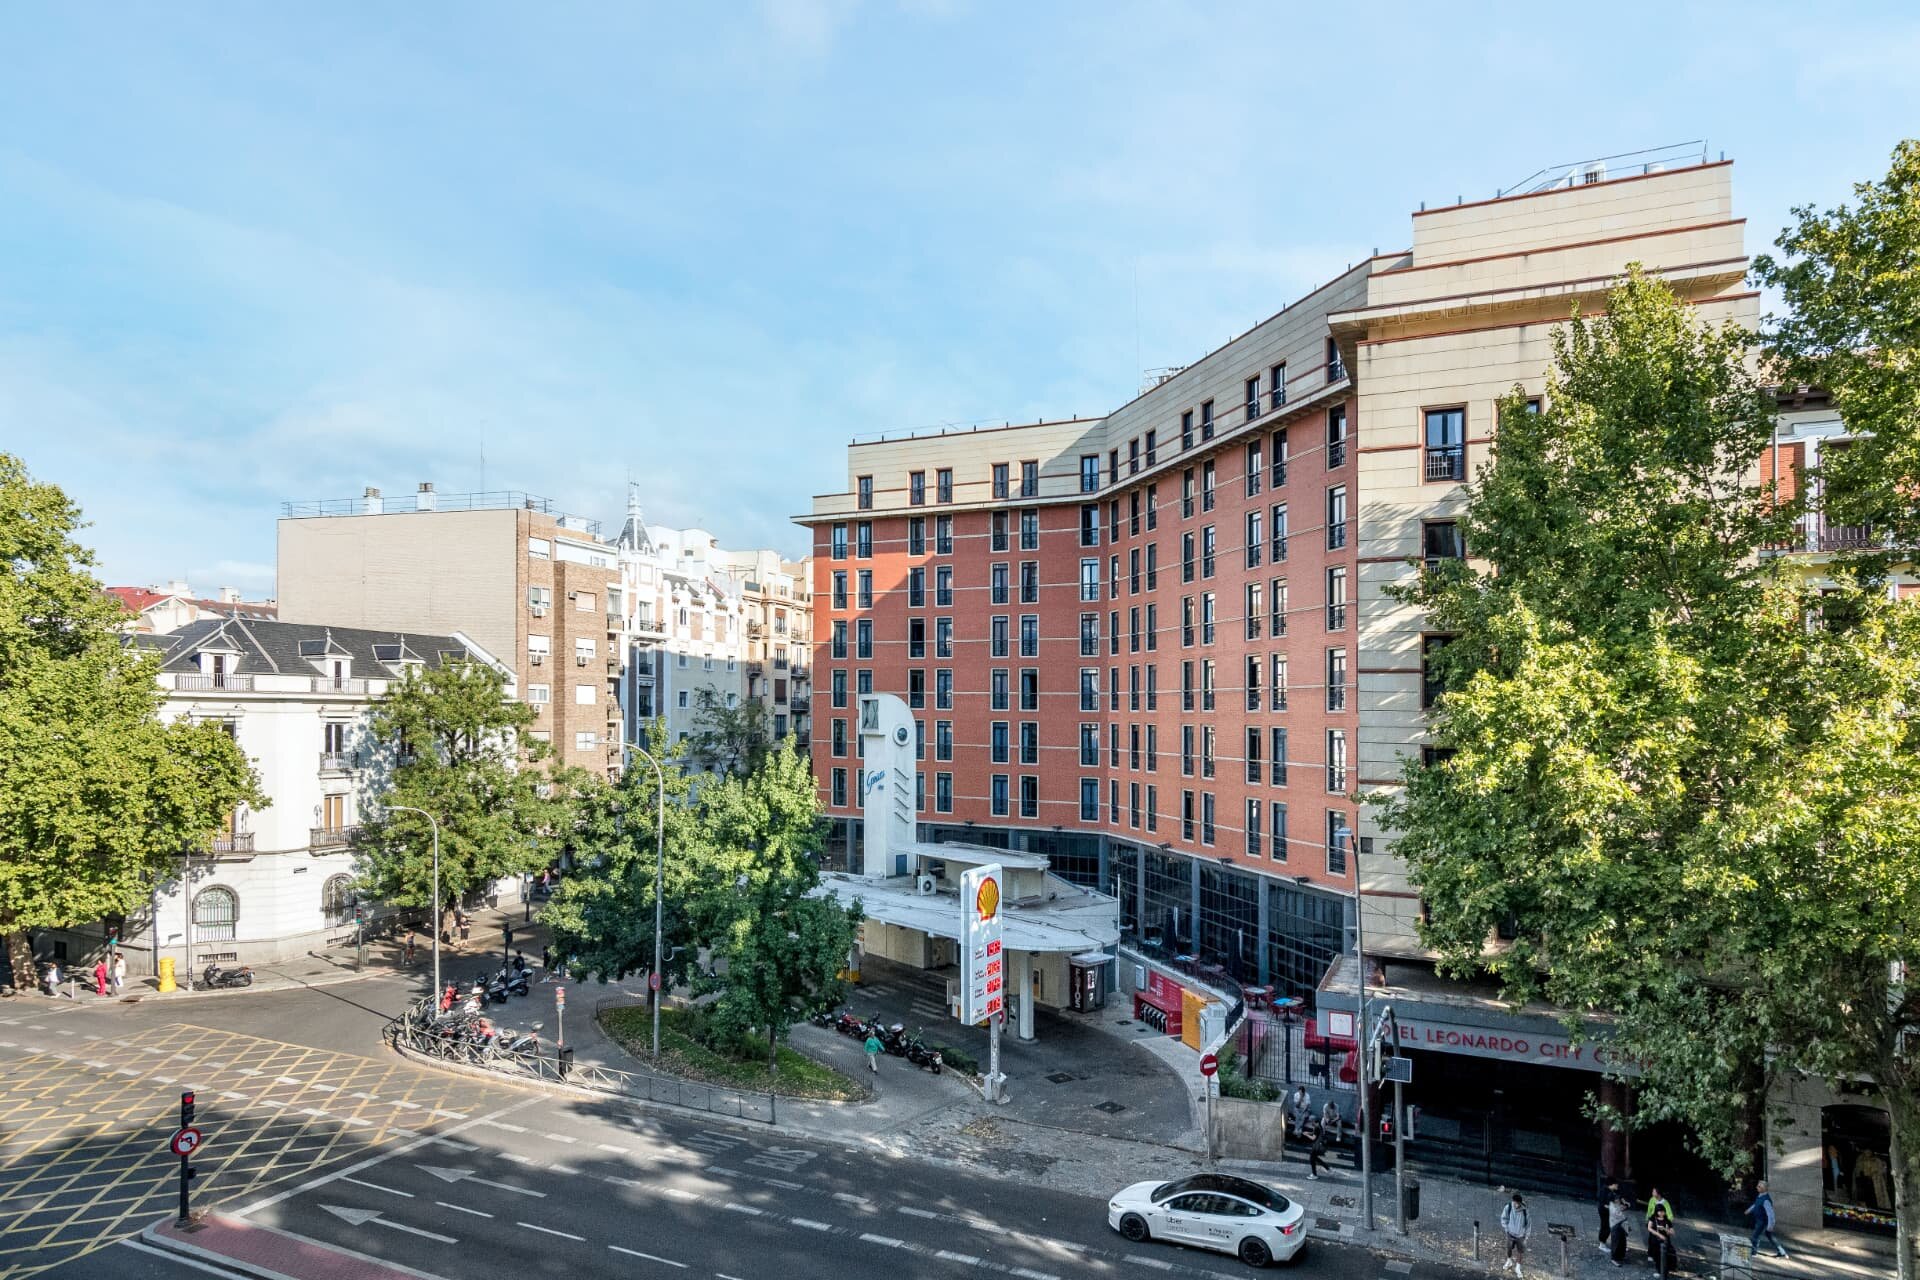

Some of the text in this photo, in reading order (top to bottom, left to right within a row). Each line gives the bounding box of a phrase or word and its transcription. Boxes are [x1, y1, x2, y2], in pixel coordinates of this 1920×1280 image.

[1426, 1028, 1529, 1054] LEONARDO
[1539, 1042, 1583, 1060] CITY
[744, 1145, 819, 1173] BUS
[1166, 1216, 1183, 1225] Uber
